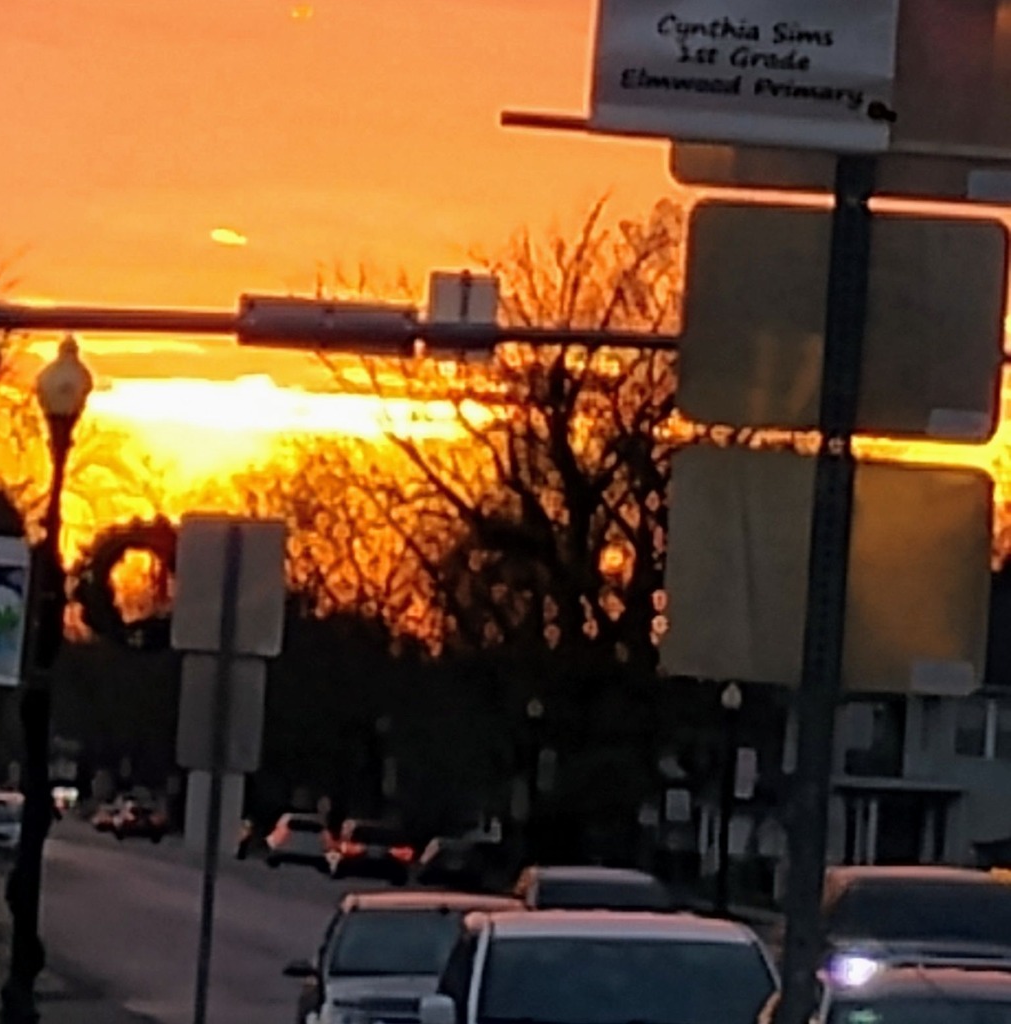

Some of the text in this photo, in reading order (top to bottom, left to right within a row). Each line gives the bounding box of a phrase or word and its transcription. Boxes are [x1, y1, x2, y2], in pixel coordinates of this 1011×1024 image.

[656, 13, 834, 48] Cynthia Sims
[677, 45, 810, 72] 1st Grade
[619, 68, 864, 109] Elmwood Primary
